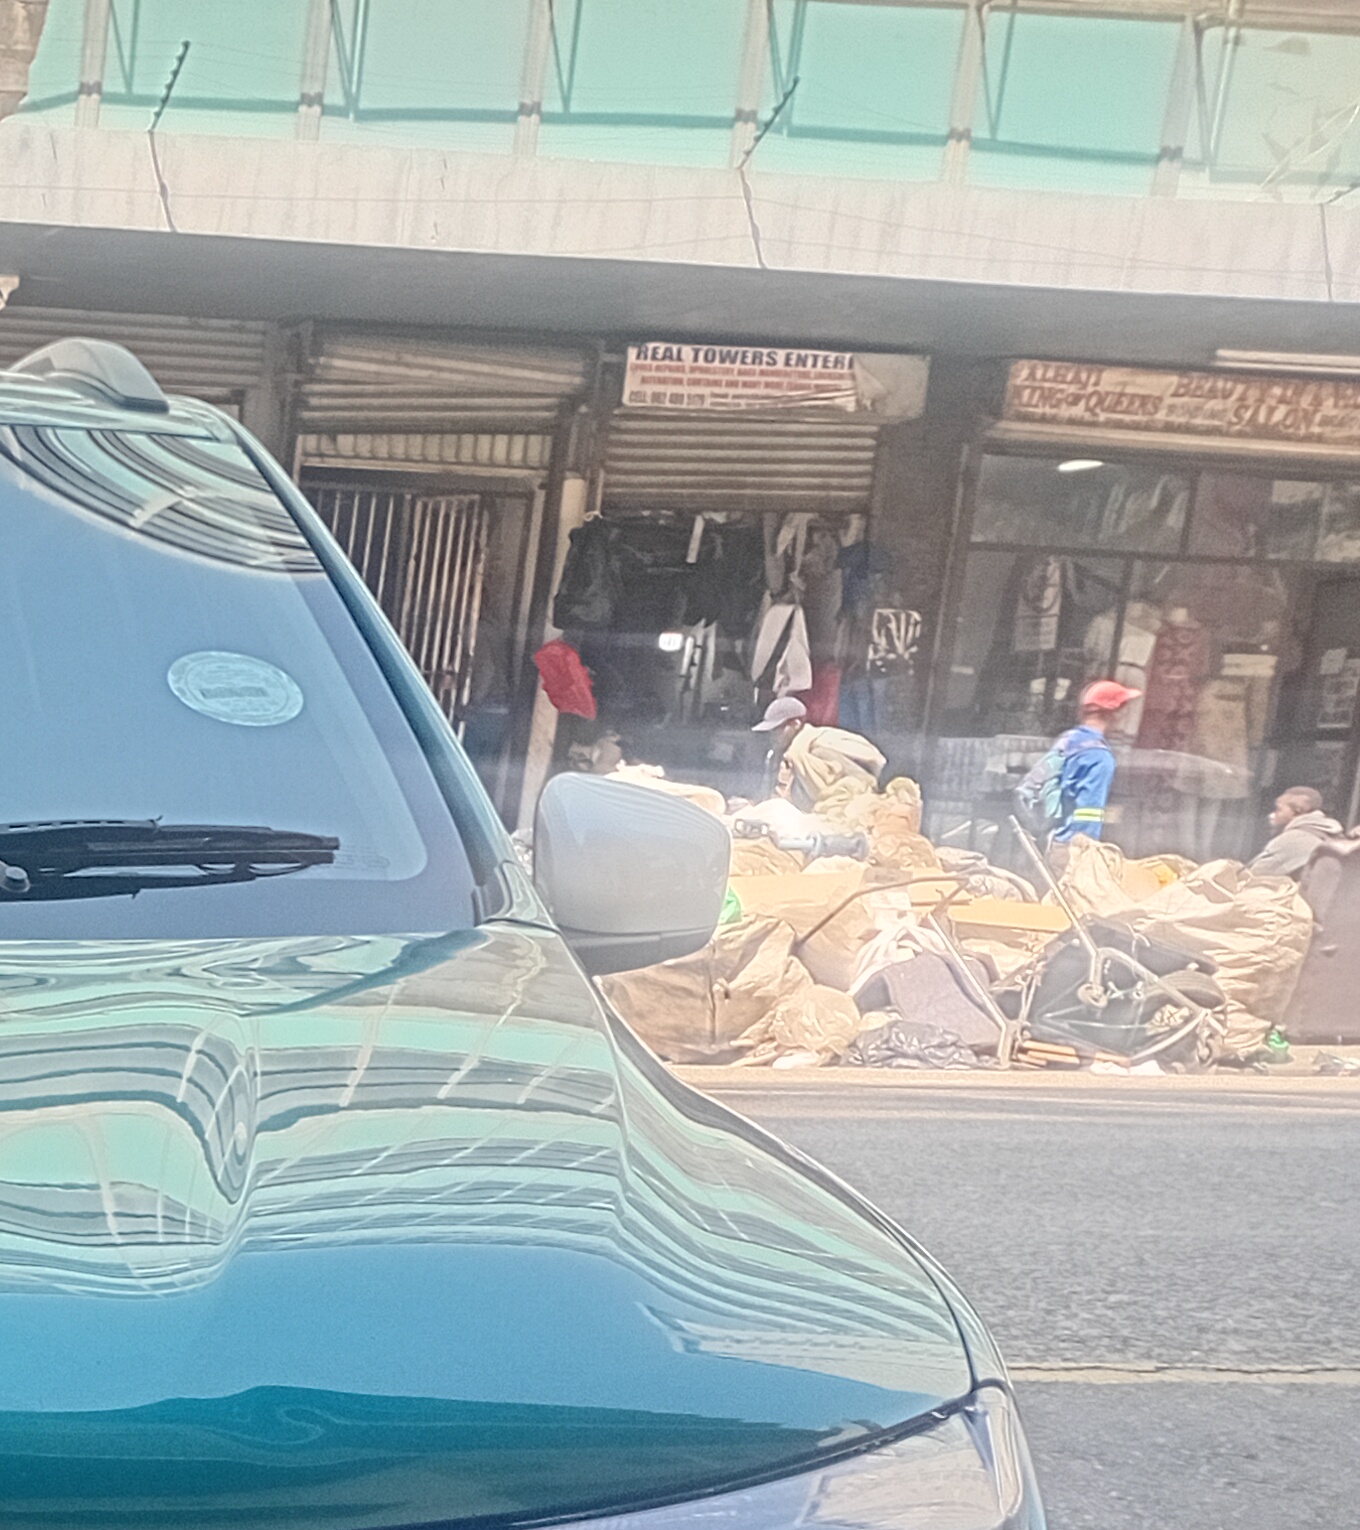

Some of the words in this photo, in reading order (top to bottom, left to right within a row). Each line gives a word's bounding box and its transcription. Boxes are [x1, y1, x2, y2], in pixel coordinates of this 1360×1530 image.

[636, 345, 684, 362] REAL
[692, 347, 778, 367] TOWERS
[1084, 389, 1164, 417] QUEENS
[1232, 403, 1323, 432] SALON
